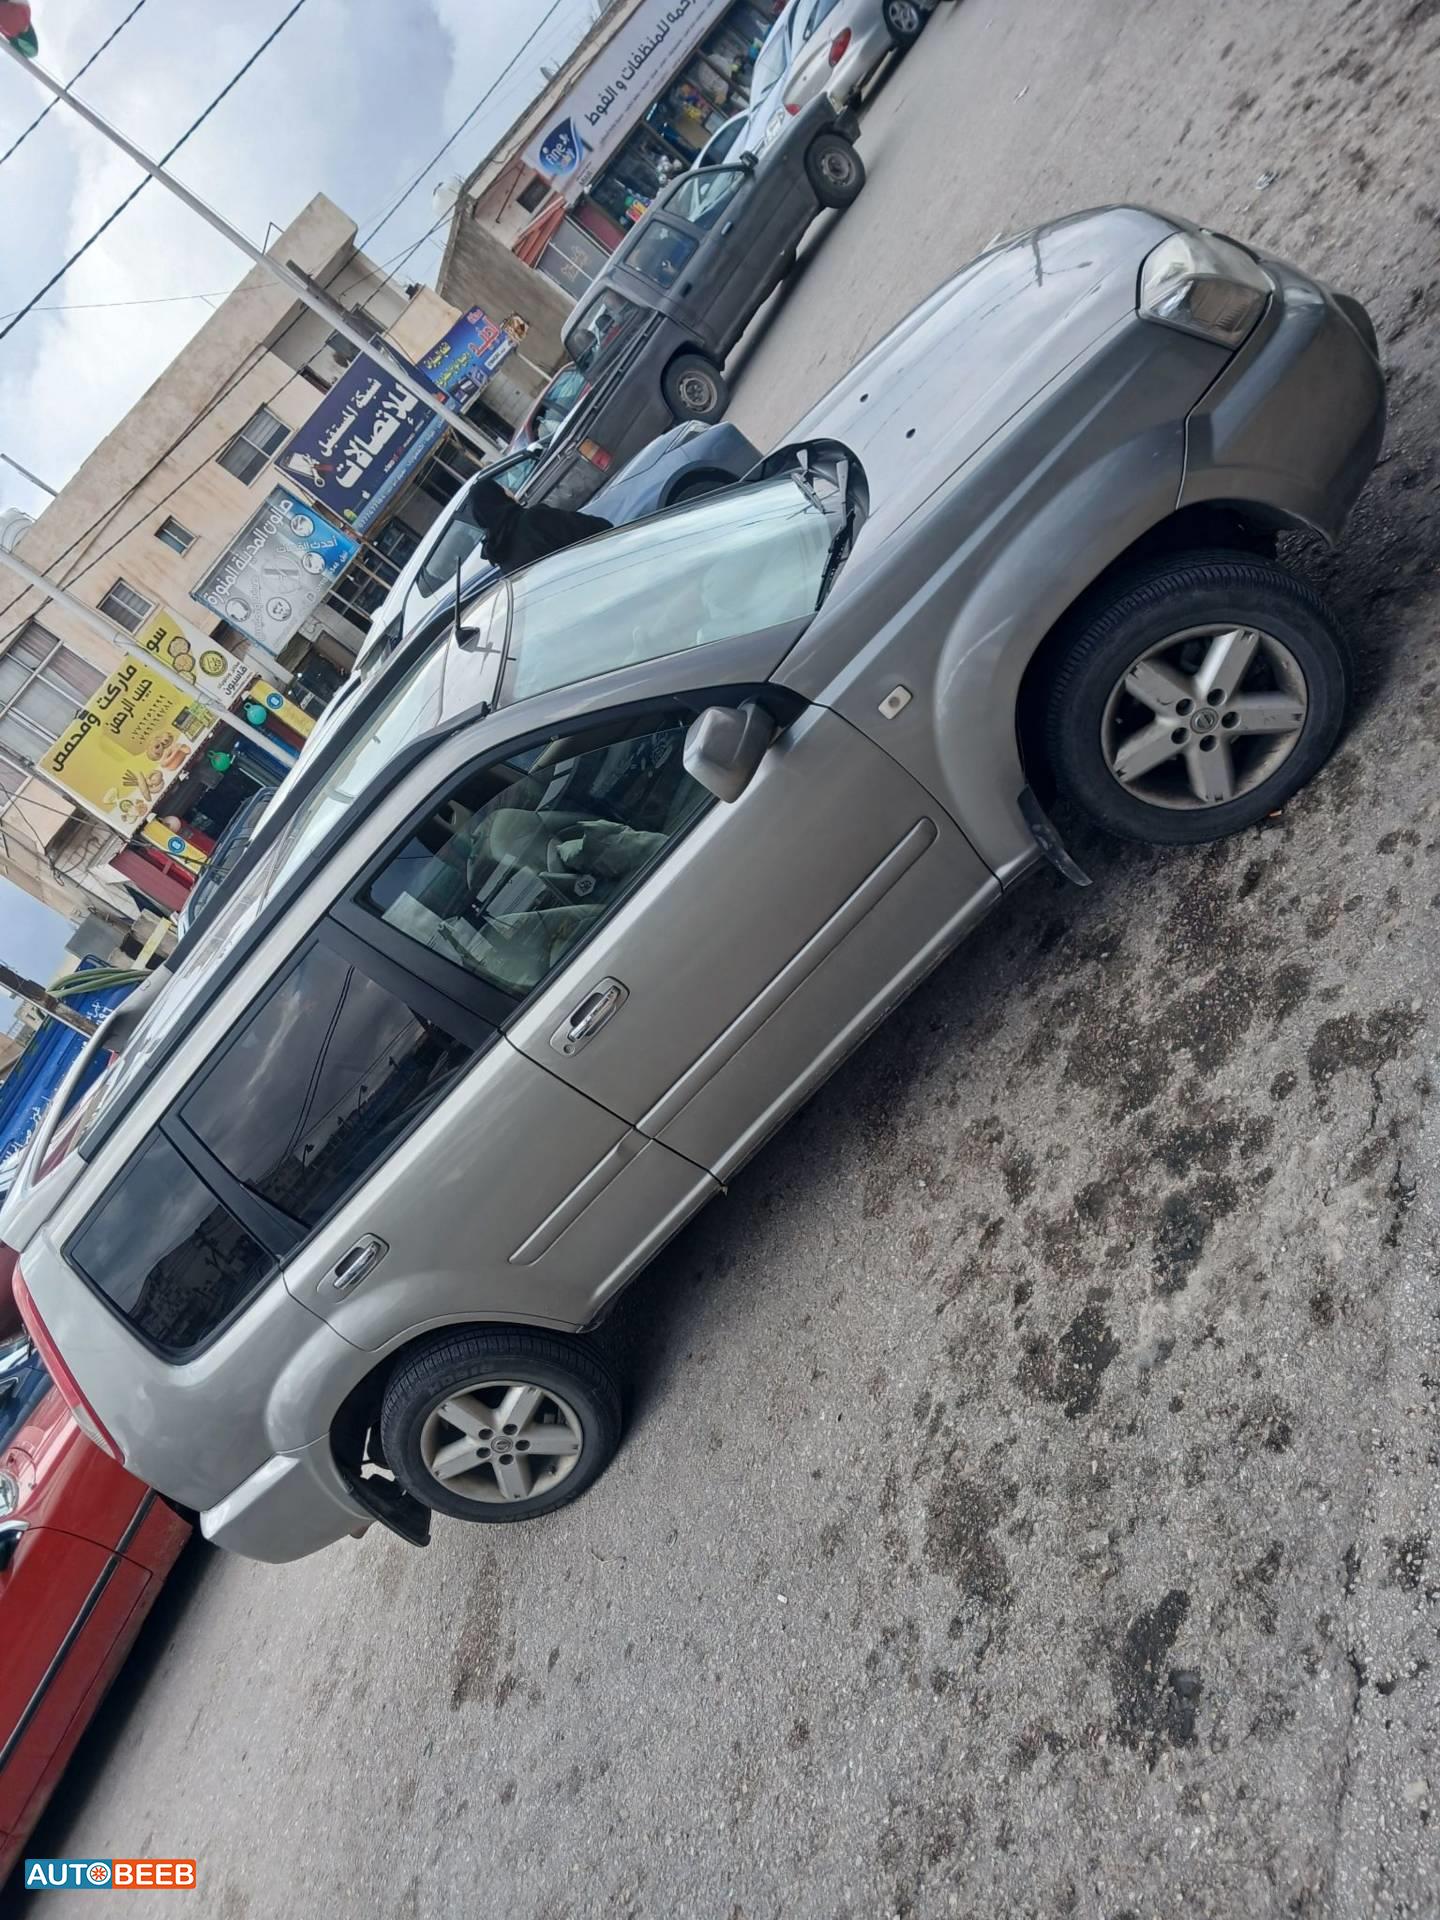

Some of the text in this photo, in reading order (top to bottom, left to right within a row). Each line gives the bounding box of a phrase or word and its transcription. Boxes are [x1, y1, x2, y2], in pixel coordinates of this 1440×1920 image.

[666, 0, 696, 24] حمه
[621, 19, 670, 81] للمنظفات
[584, 85, 618, 126] الفوط
[615, 80, 628, 91] و
[543, 142, 565, 165] fine
[318, 377, 382, 457] شبكة المستقبل
[336, 382, 419, 488] للإتصالات
[264, 499, 293, 534] صالون
[231, 527, 268, 571] المدينة
[203, 564, 239, 606] المنورة
[98, 663, 138, 710] ماركت
[224, 665, 248, 696] قاسيون
[105, 678, 153, 735] حبيب الرحمن
[52, 712, 101, 773] ومحمص
